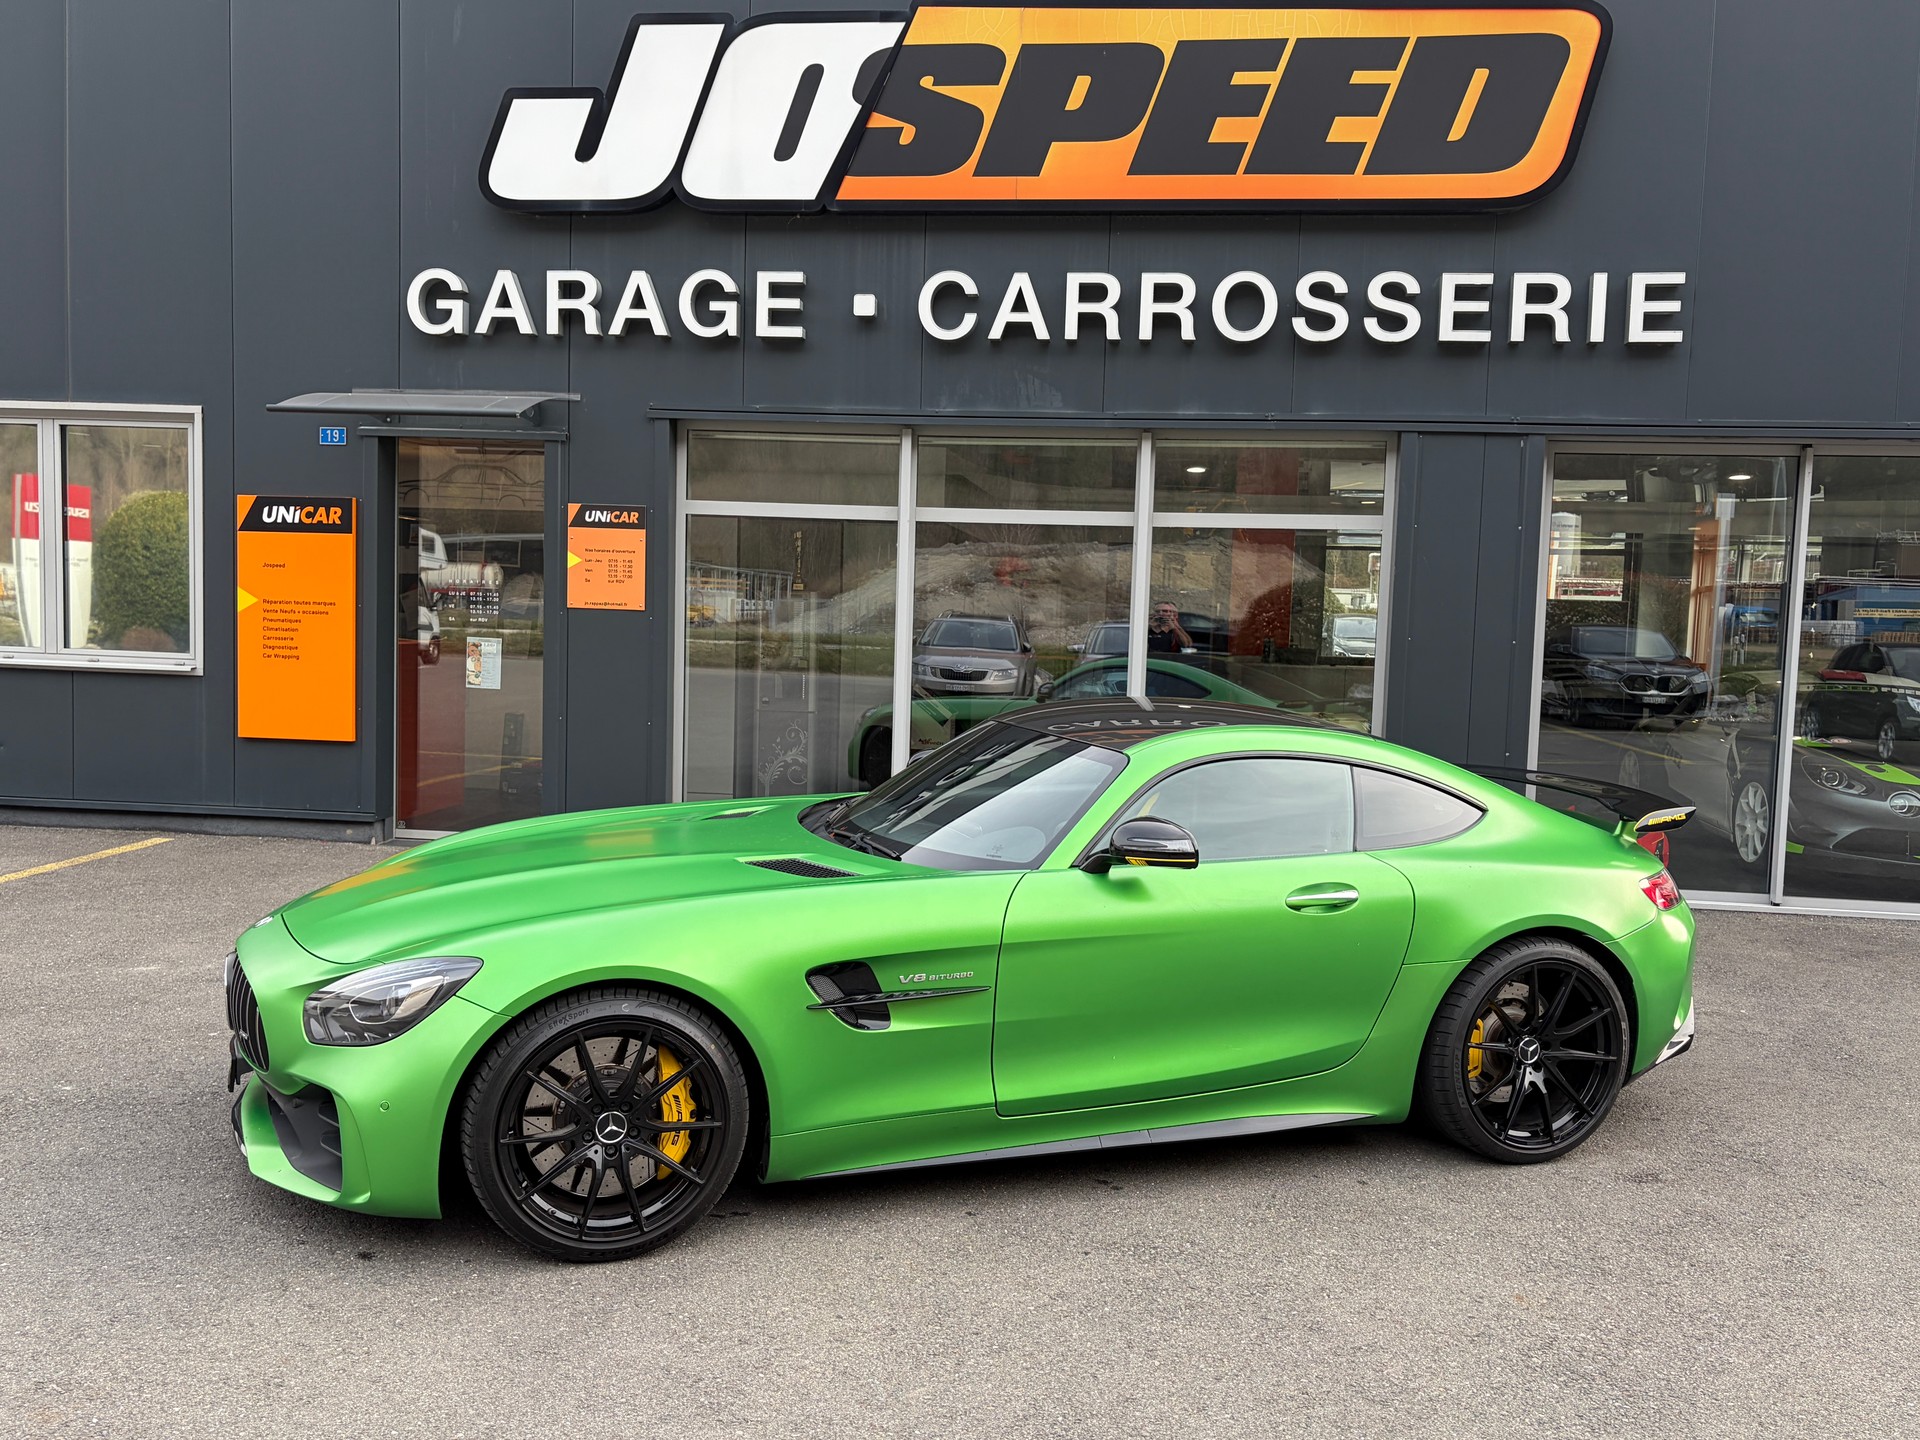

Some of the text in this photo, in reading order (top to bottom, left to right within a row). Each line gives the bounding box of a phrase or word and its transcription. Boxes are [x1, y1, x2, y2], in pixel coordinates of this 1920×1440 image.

[406, 267, 1687, 346] GARAGE CARROSSERIE
[326, 429, 339, 442] 19
[899, 971, 974, 984] V8 BITURBO
